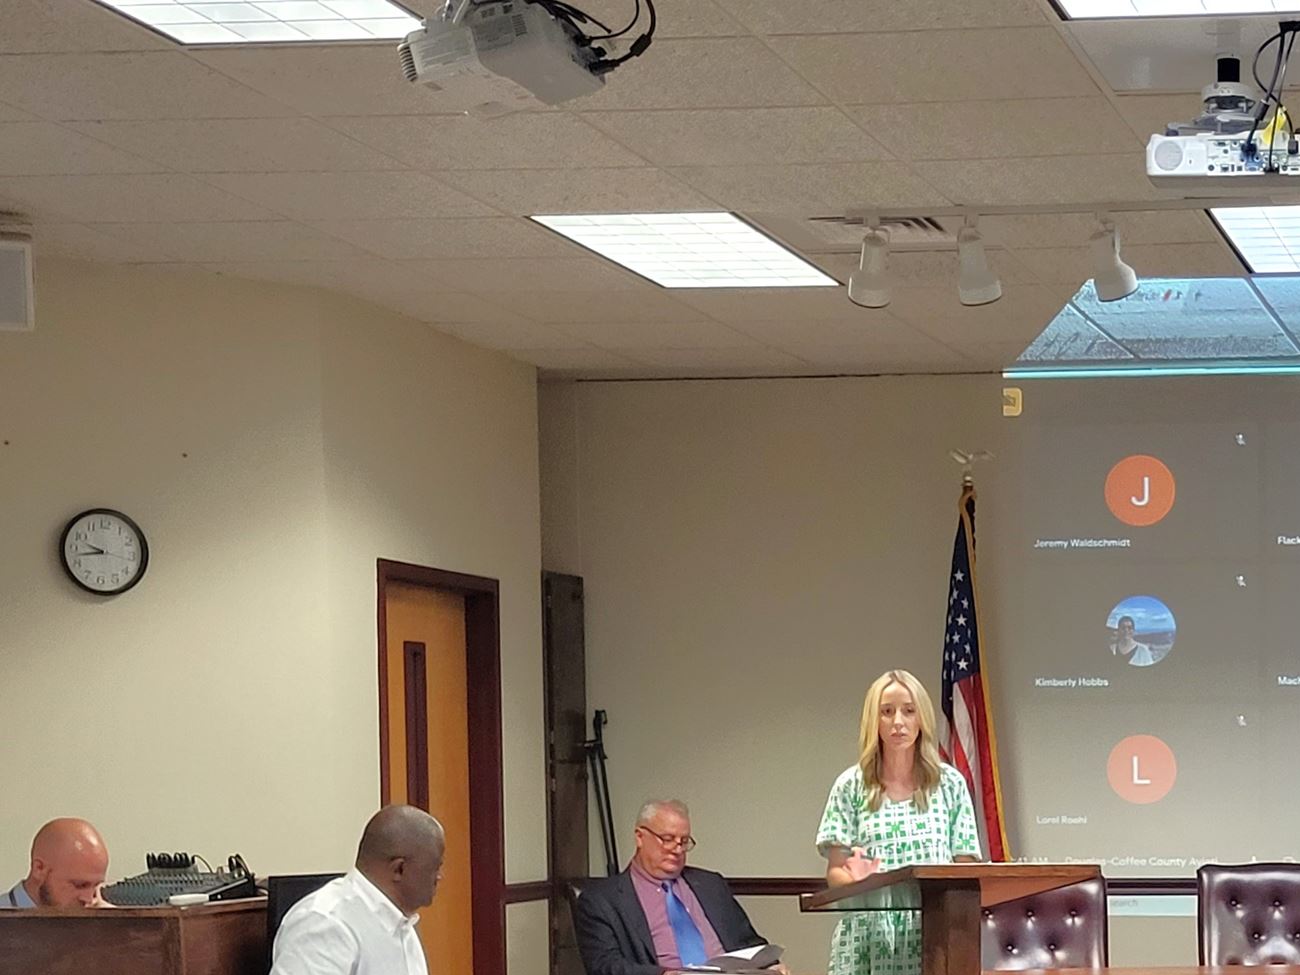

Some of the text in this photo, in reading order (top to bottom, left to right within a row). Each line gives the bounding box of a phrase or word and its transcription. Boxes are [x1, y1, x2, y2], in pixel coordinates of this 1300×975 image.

[1131, 476, 1149, 506] J
[87, 521, 96, 532] 11
[100, 518, 112, 530] 12
[124, 535, 133, 546] 2
[1034, 539, 1068, 549] Jeremy
[83, 569, 92, 580] 7
[96, 575, 106, 585] 6
[110, 572, 120, 585] 5
[1034, 678, 1109, 688] Kimberly Hobbs
[1132, 755, 1152, 785] L
[1148, 856, 1187, 868] County
